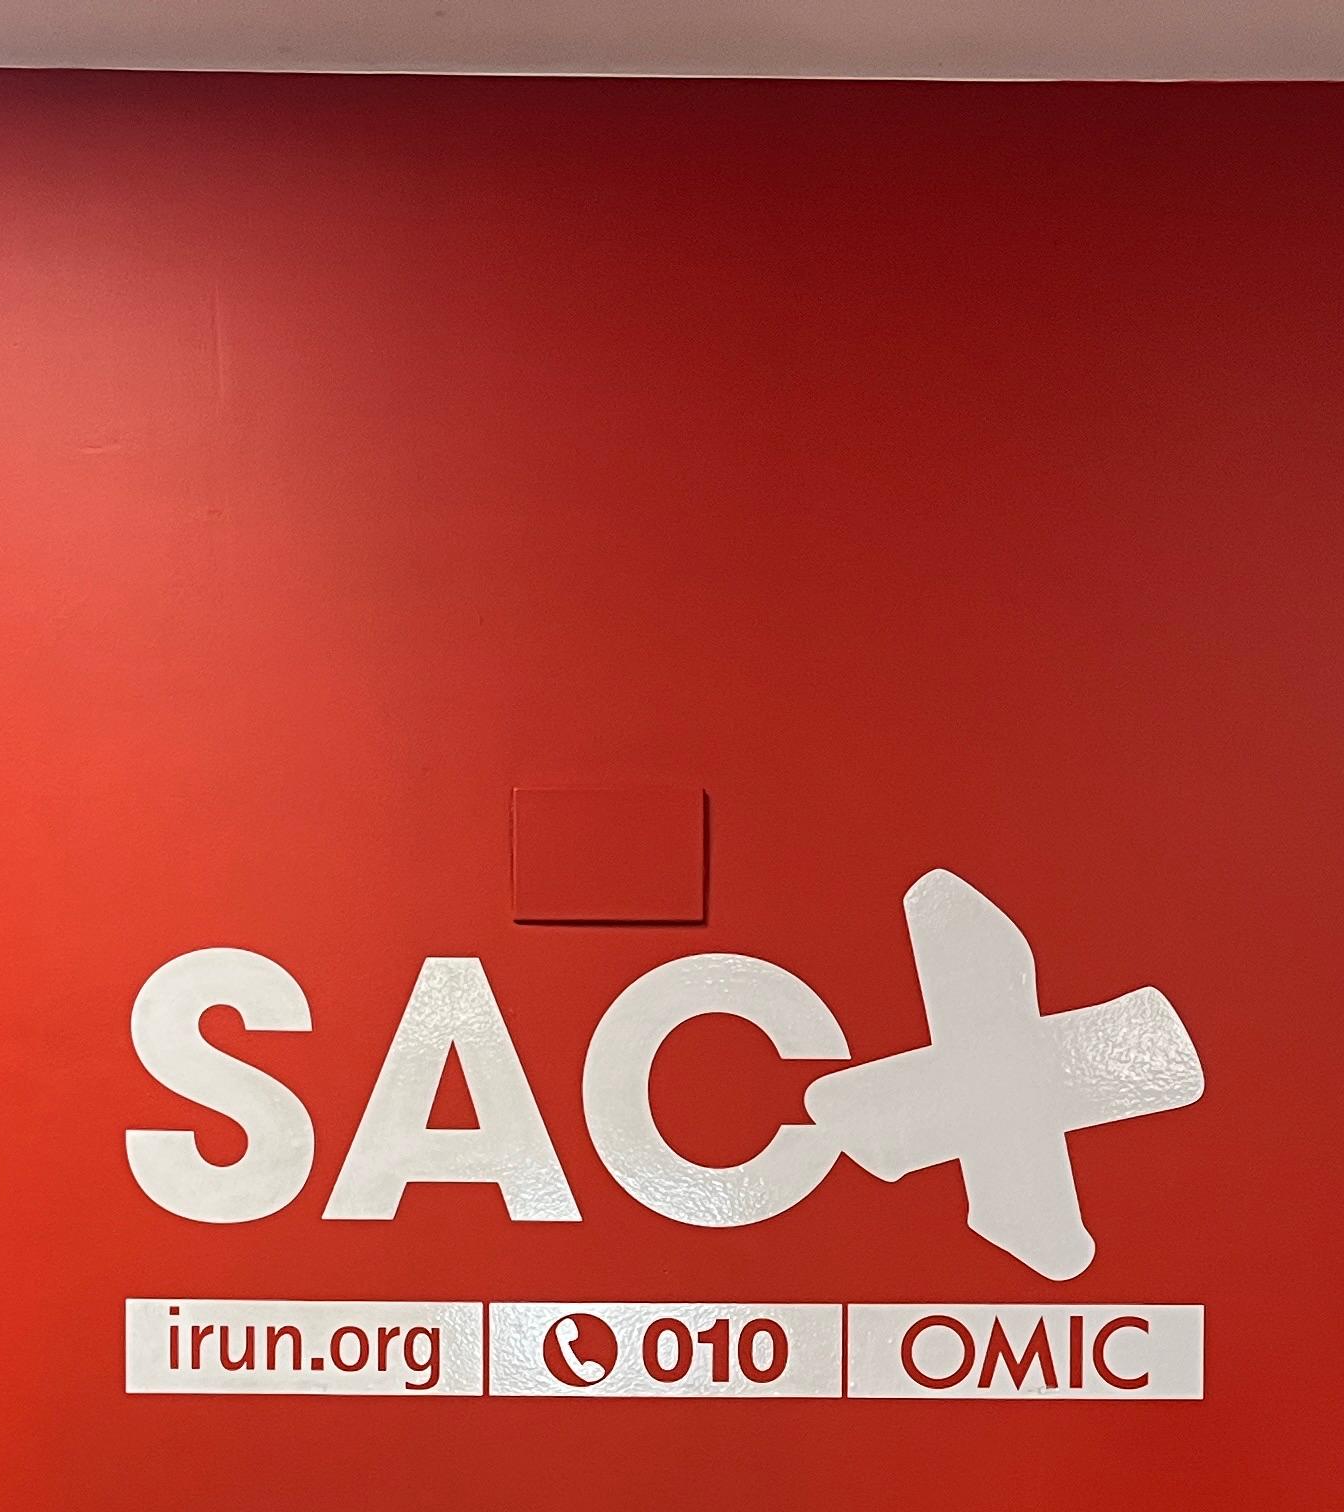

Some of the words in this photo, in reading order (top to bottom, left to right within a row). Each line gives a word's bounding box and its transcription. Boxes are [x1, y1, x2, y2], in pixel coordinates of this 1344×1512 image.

[166, 1308, 442, 1390] irun.org
[642, 1317, 790, 1386] 010
[900, 1315, 1150, 1390] OMIC
